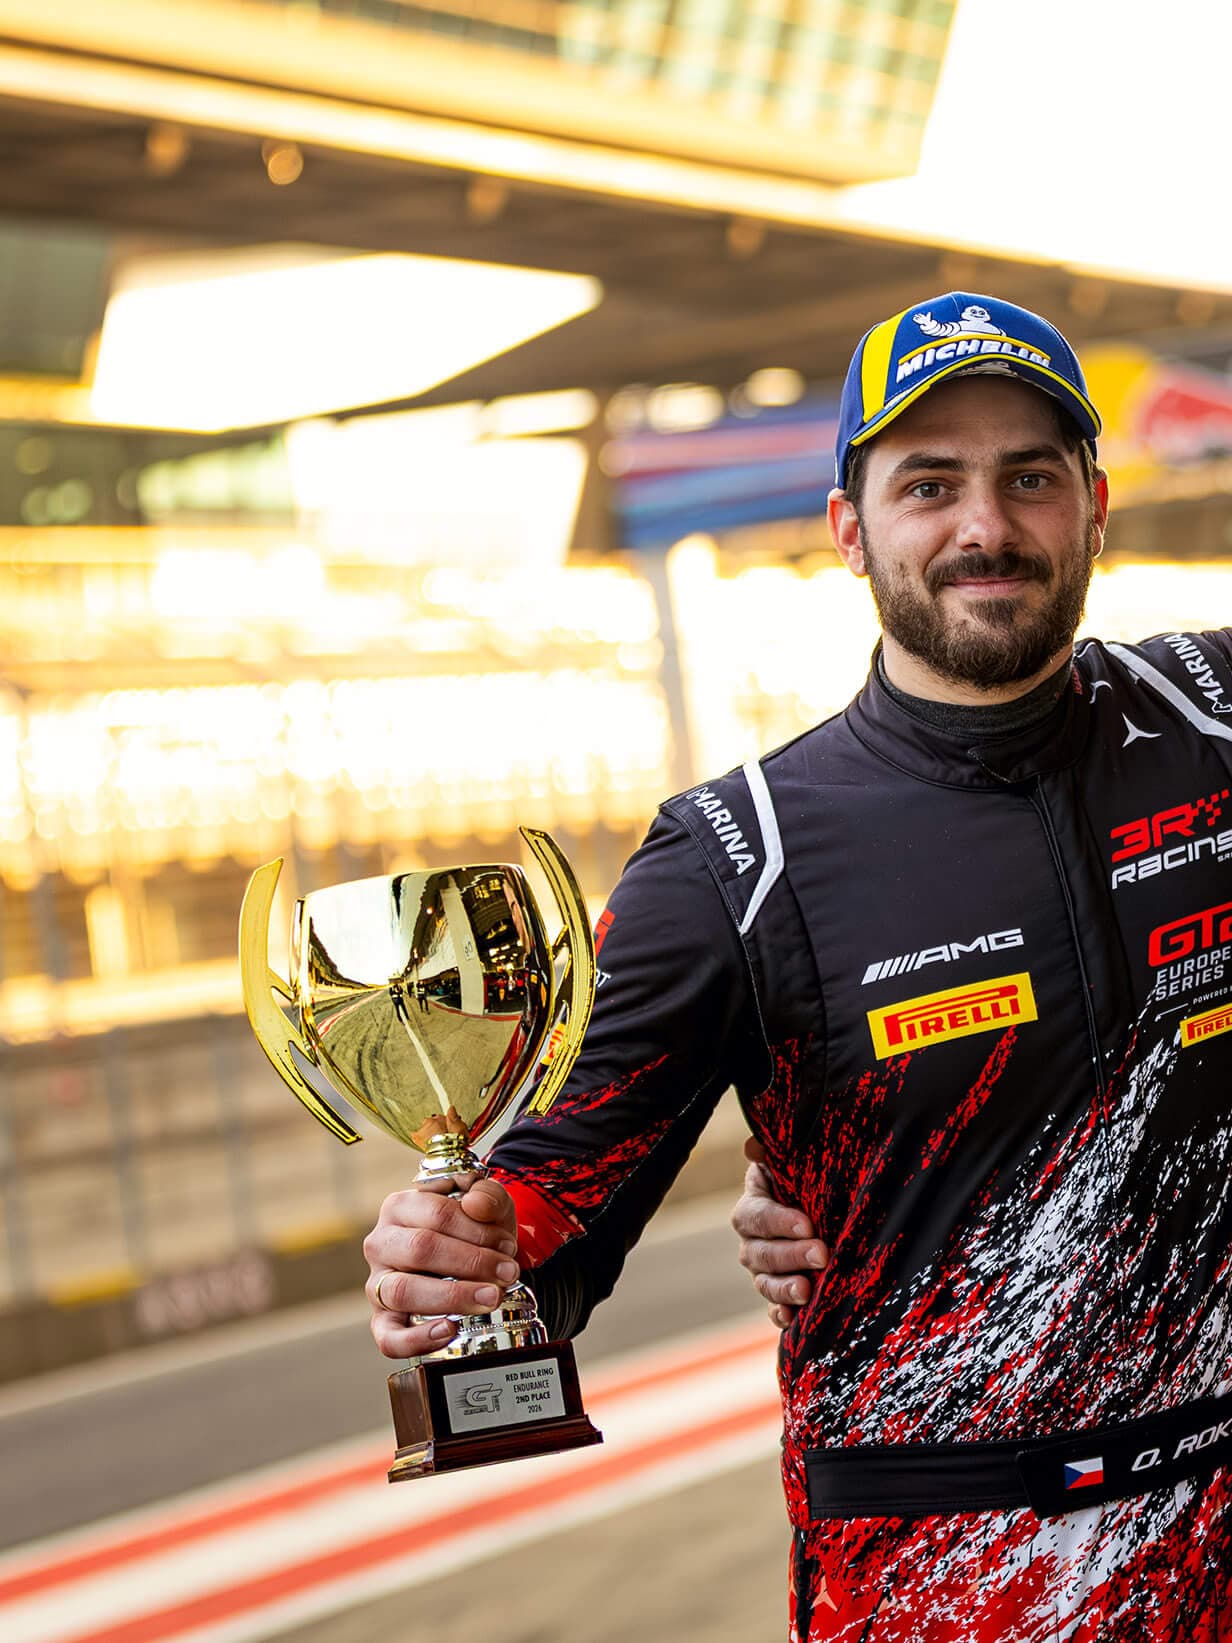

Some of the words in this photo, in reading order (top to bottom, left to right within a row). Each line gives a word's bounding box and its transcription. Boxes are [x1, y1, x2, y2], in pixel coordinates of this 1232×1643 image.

[896, 339, 1052, 384] MICHELIN
[686, 786, 757, 876] MARINA
[1155, 964, 1225, 1001] SERIES
[1192, 987, 1228, 1004] POWERED
[884, 984, 1021, 1047] PIRELLI
[505, 1373, 519, 1382] RED
[520, 1370, 536, 1380] BULL
[537, 1367, 554, 1377] RING
[513, 1379, 550, 1393] ENDURANCE
[516, 1394, 530, 1404] 2ND
[531, 1391, 551, 1401] PLACE
[1131, 1448, 1162, 1472] O.
